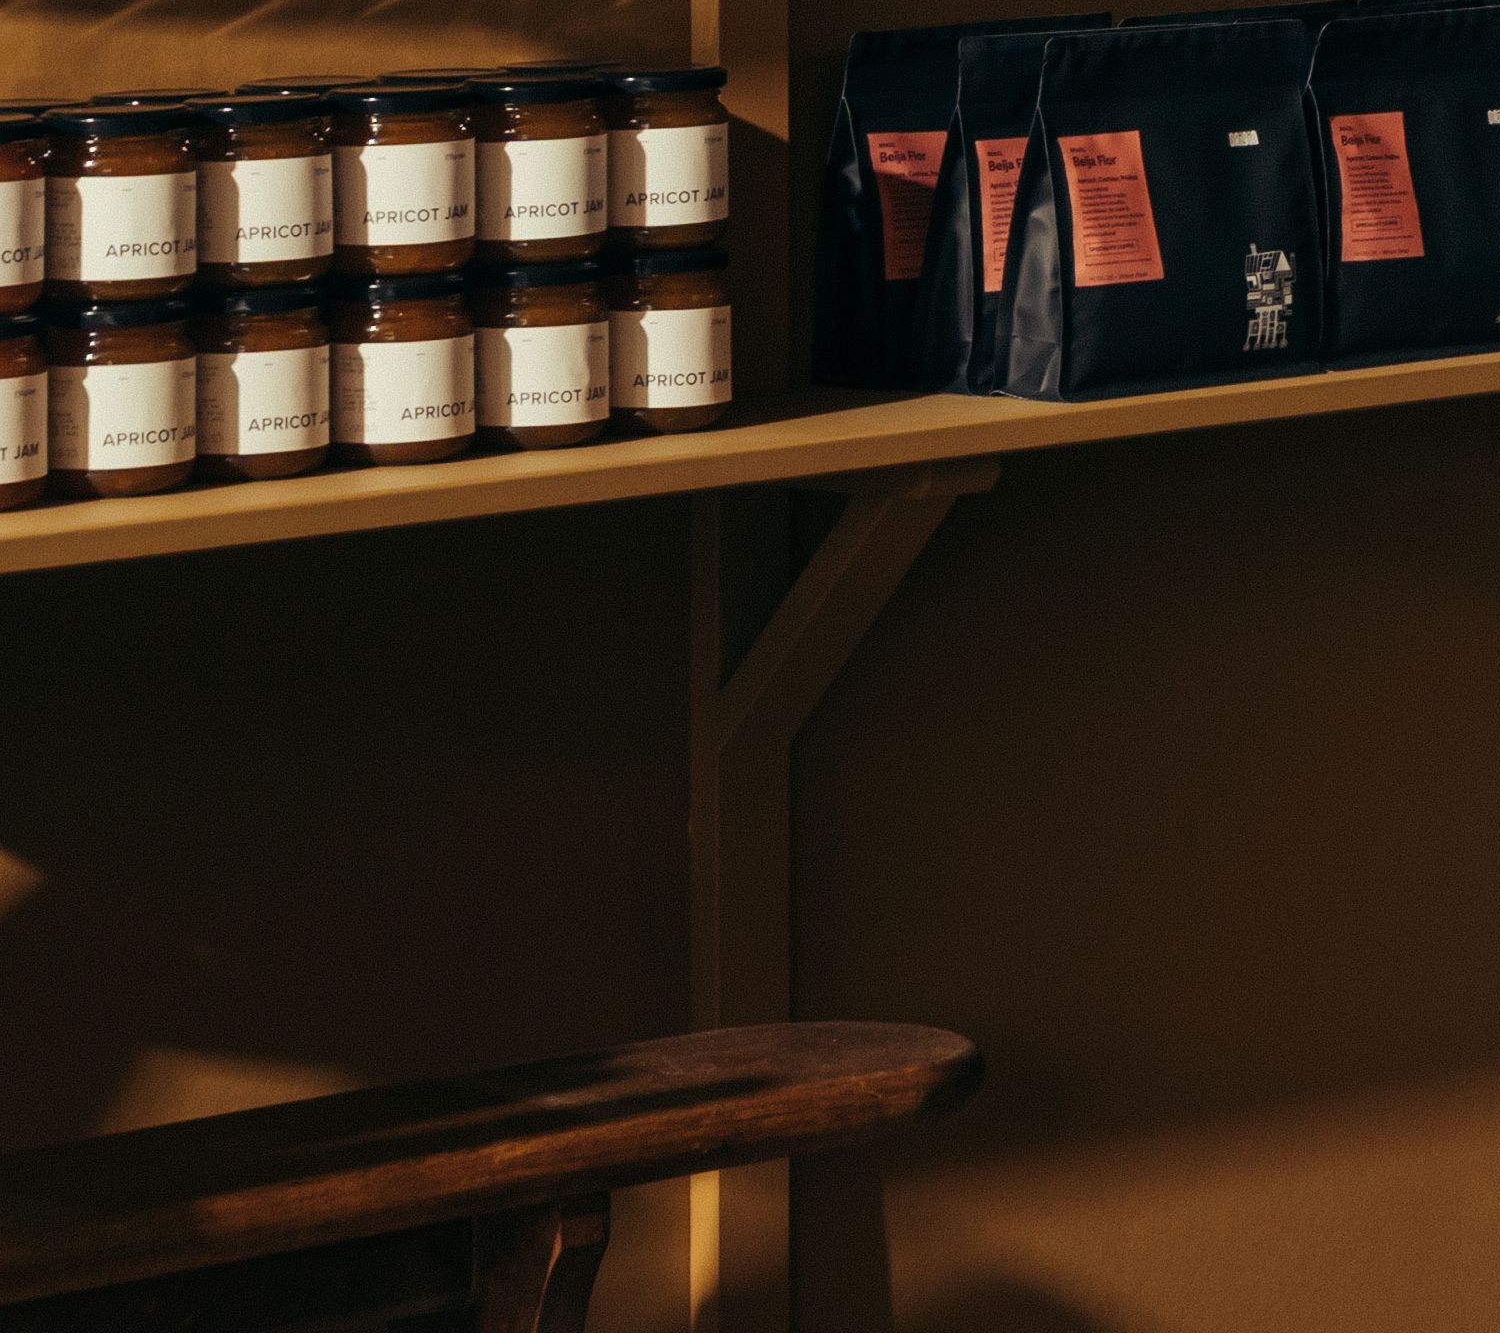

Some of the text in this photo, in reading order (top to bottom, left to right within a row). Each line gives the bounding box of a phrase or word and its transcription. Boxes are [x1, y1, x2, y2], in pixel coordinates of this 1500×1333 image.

[988, 159, 1014, 173] Beija
[626, 185, 725, 207] APRICOT JAM
[363, 204, 469, 225] APRICOT JAM
[504, 198, 605, 220] APRICOT JAM
[236, 222, 311, 242] APRICOT
[106, 240, 181, 259] APRICOT
[633, 367, 729, 388] APRICOT JAM
[507, 385, 606, 406] APRICOT JAM
[401, 402, 466, 421] APRICOT
[248, 414, 318, 433] APRICOT
[103, 427, 178, 447] APRICOT
[14, 442, 40, 459] JAM
